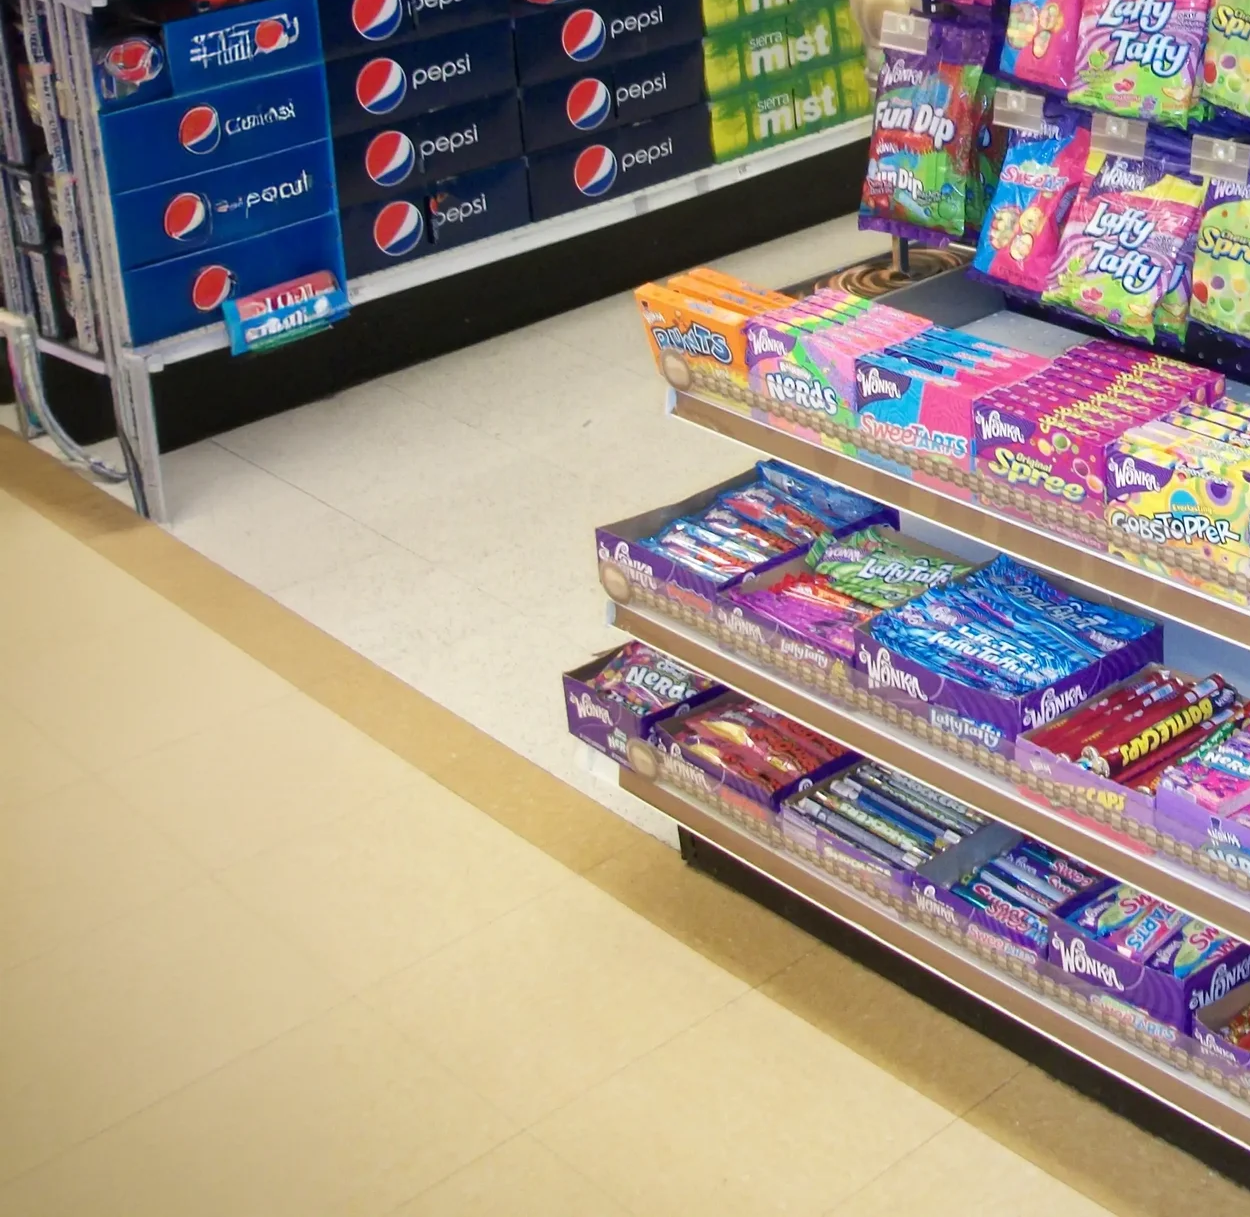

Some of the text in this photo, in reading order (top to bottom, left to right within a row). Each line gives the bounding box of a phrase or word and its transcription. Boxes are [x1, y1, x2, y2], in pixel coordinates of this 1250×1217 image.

[611, 5, 663, 38] pepsi
[750, 32, 783, 48] sierra
[1111, 29, 1191, 78] Taffy
[413, 53, 471, 89] pepsi
[616, 72, 667, 106] pepsi
[757, 93, 789, 112] sierra
[419, 124, 479, 159] pepsi
[622, 138, 673, 172] pepsi
[1083, 201, 1156, 250] Laffy
[1087, 239, 1163, 294] Taffy
[750, 327, 787, 357] WONKA
[857, 368, 902, 399] WONKA
[976, 410, 1025, 444] WONKA
[988, 447, 1087, 503] Spree
[1015, 452, 1052, 475] Original
[1108, 457, 1161, 491] WONKA
[859, 644, 929, 702] WONKA
[1022, 683, 1087, 730] WONKA
[1053, 931, 1125, 992] WONKA
